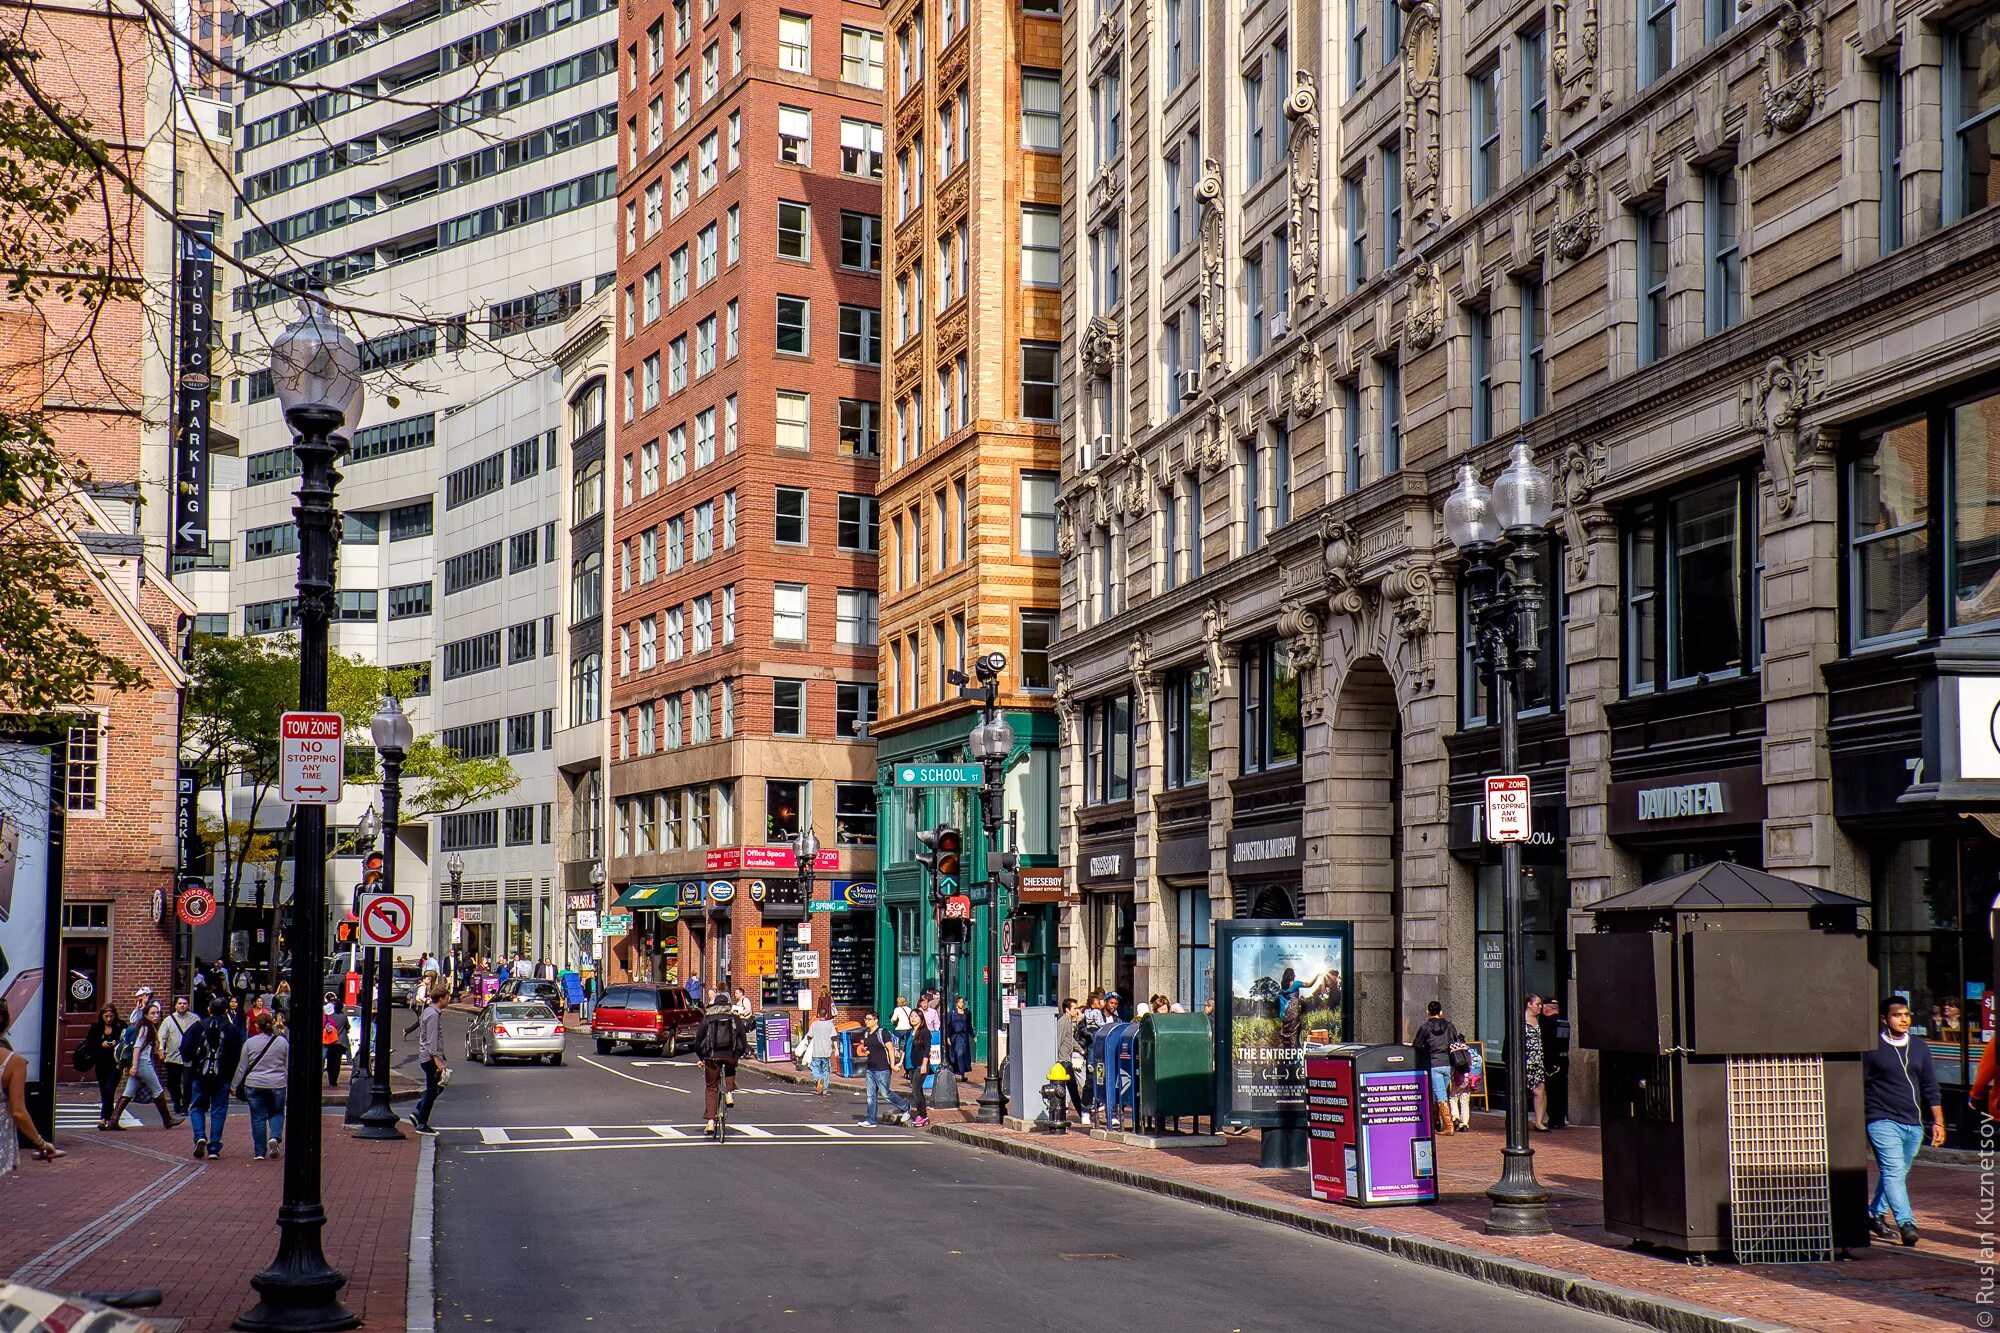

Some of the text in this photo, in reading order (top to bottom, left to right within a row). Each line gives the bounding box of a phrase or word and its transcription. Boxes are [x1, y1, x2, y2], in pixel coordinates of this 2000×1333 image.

[191, 269, 203, 365] PUBLIC
[187, 399, 201, 512] PARKING
[287, 721, 338, 735] TOW ZONE
[301, 741, 323, 753] NO
[287, 754, 336, 763] STOPPING
[302, 764, 321, 772] ANY
[301, 772, 322, 780] TIME
[920, 768, 978, 782] SCHOOL ST
[179, 781, 190, 791] P
[1490, 780, 1527, 789] TOW ZONE
[1500, 793, 1516, 803] NO
[767, 850, 785, 858] Space
[1023, 877, 1062, 887] CHEESEBOY
[180, 889, 214, 904] CHIPOTLE
[815, 902, 836, 911] SPRING
[1237, 1048, 1304, 1060] THE ENTREPR
